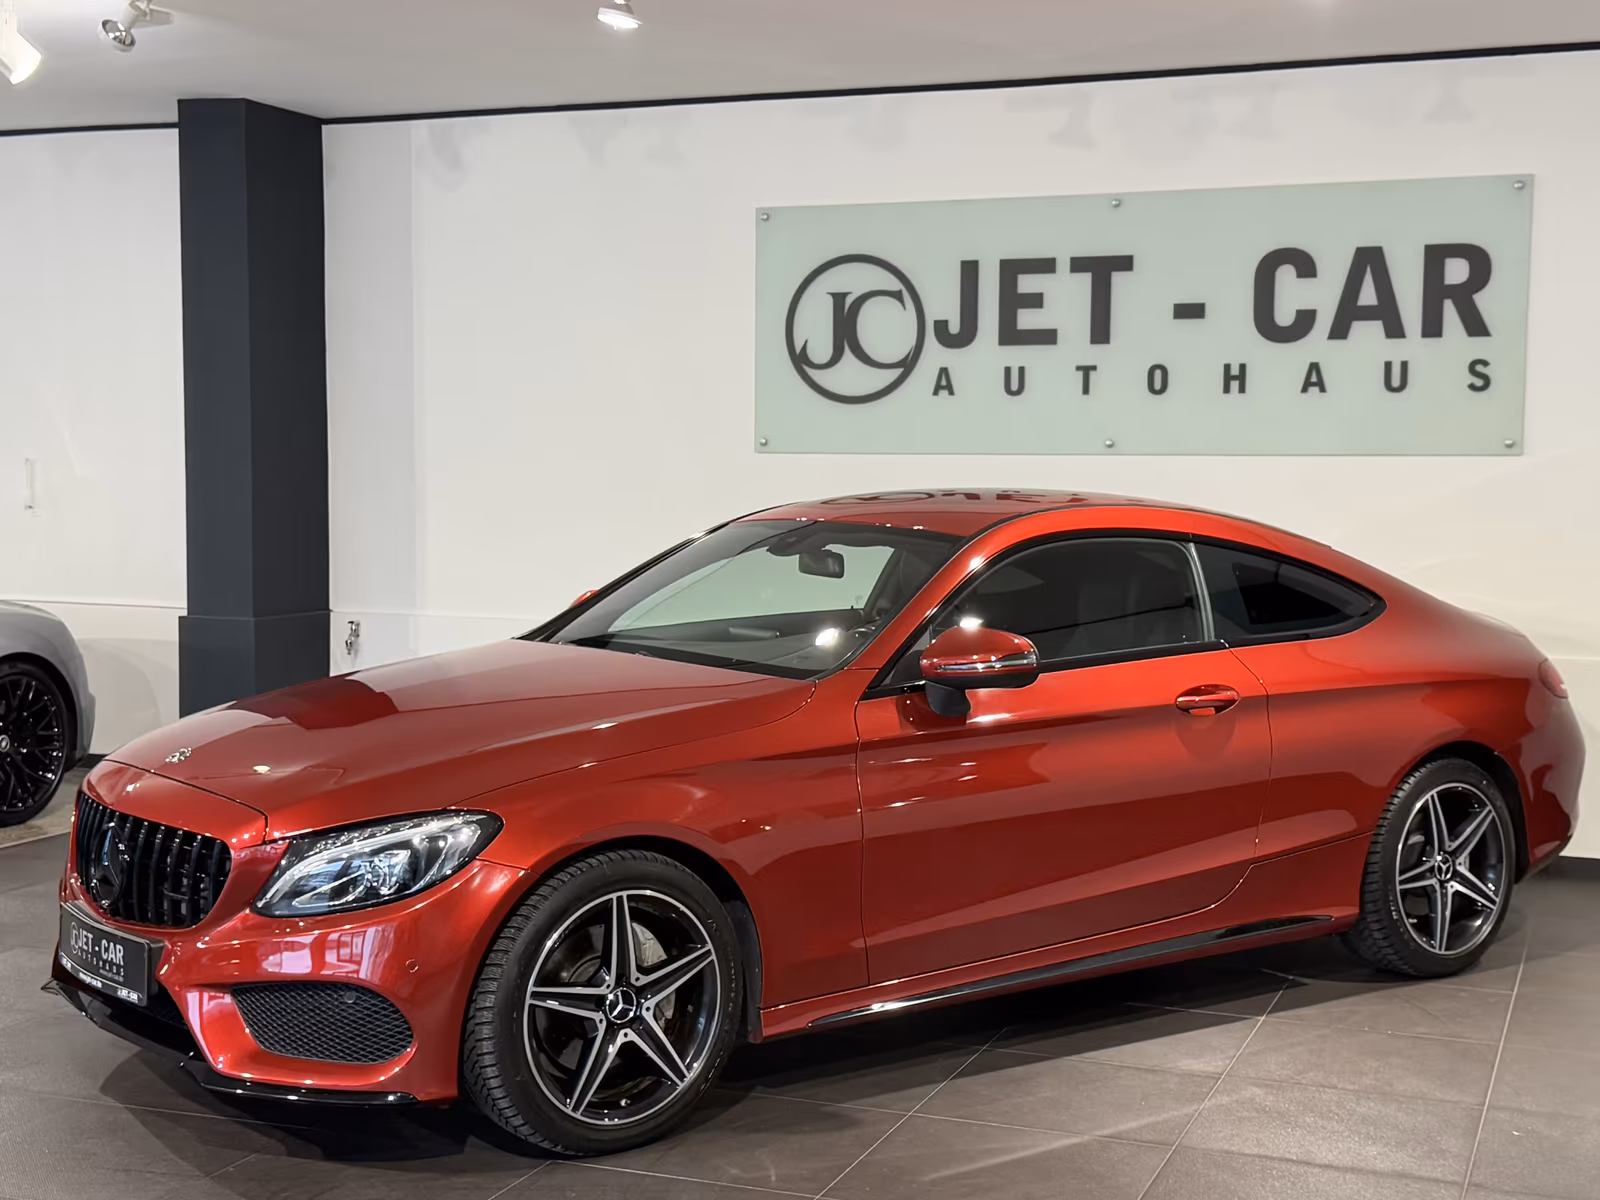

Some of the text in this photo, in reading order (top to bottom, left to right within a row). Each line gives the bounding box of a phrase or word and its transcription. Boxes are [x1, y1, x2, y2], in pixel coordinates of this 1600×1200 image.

[933, 255, 1133, 350] JET
[1253, 242, 1491, 344] CAR
[932, 359, 1491, 396] AUTOHAUS
[78, 928, 93, 952] JET
[101, 939, 124, 966] CAR
